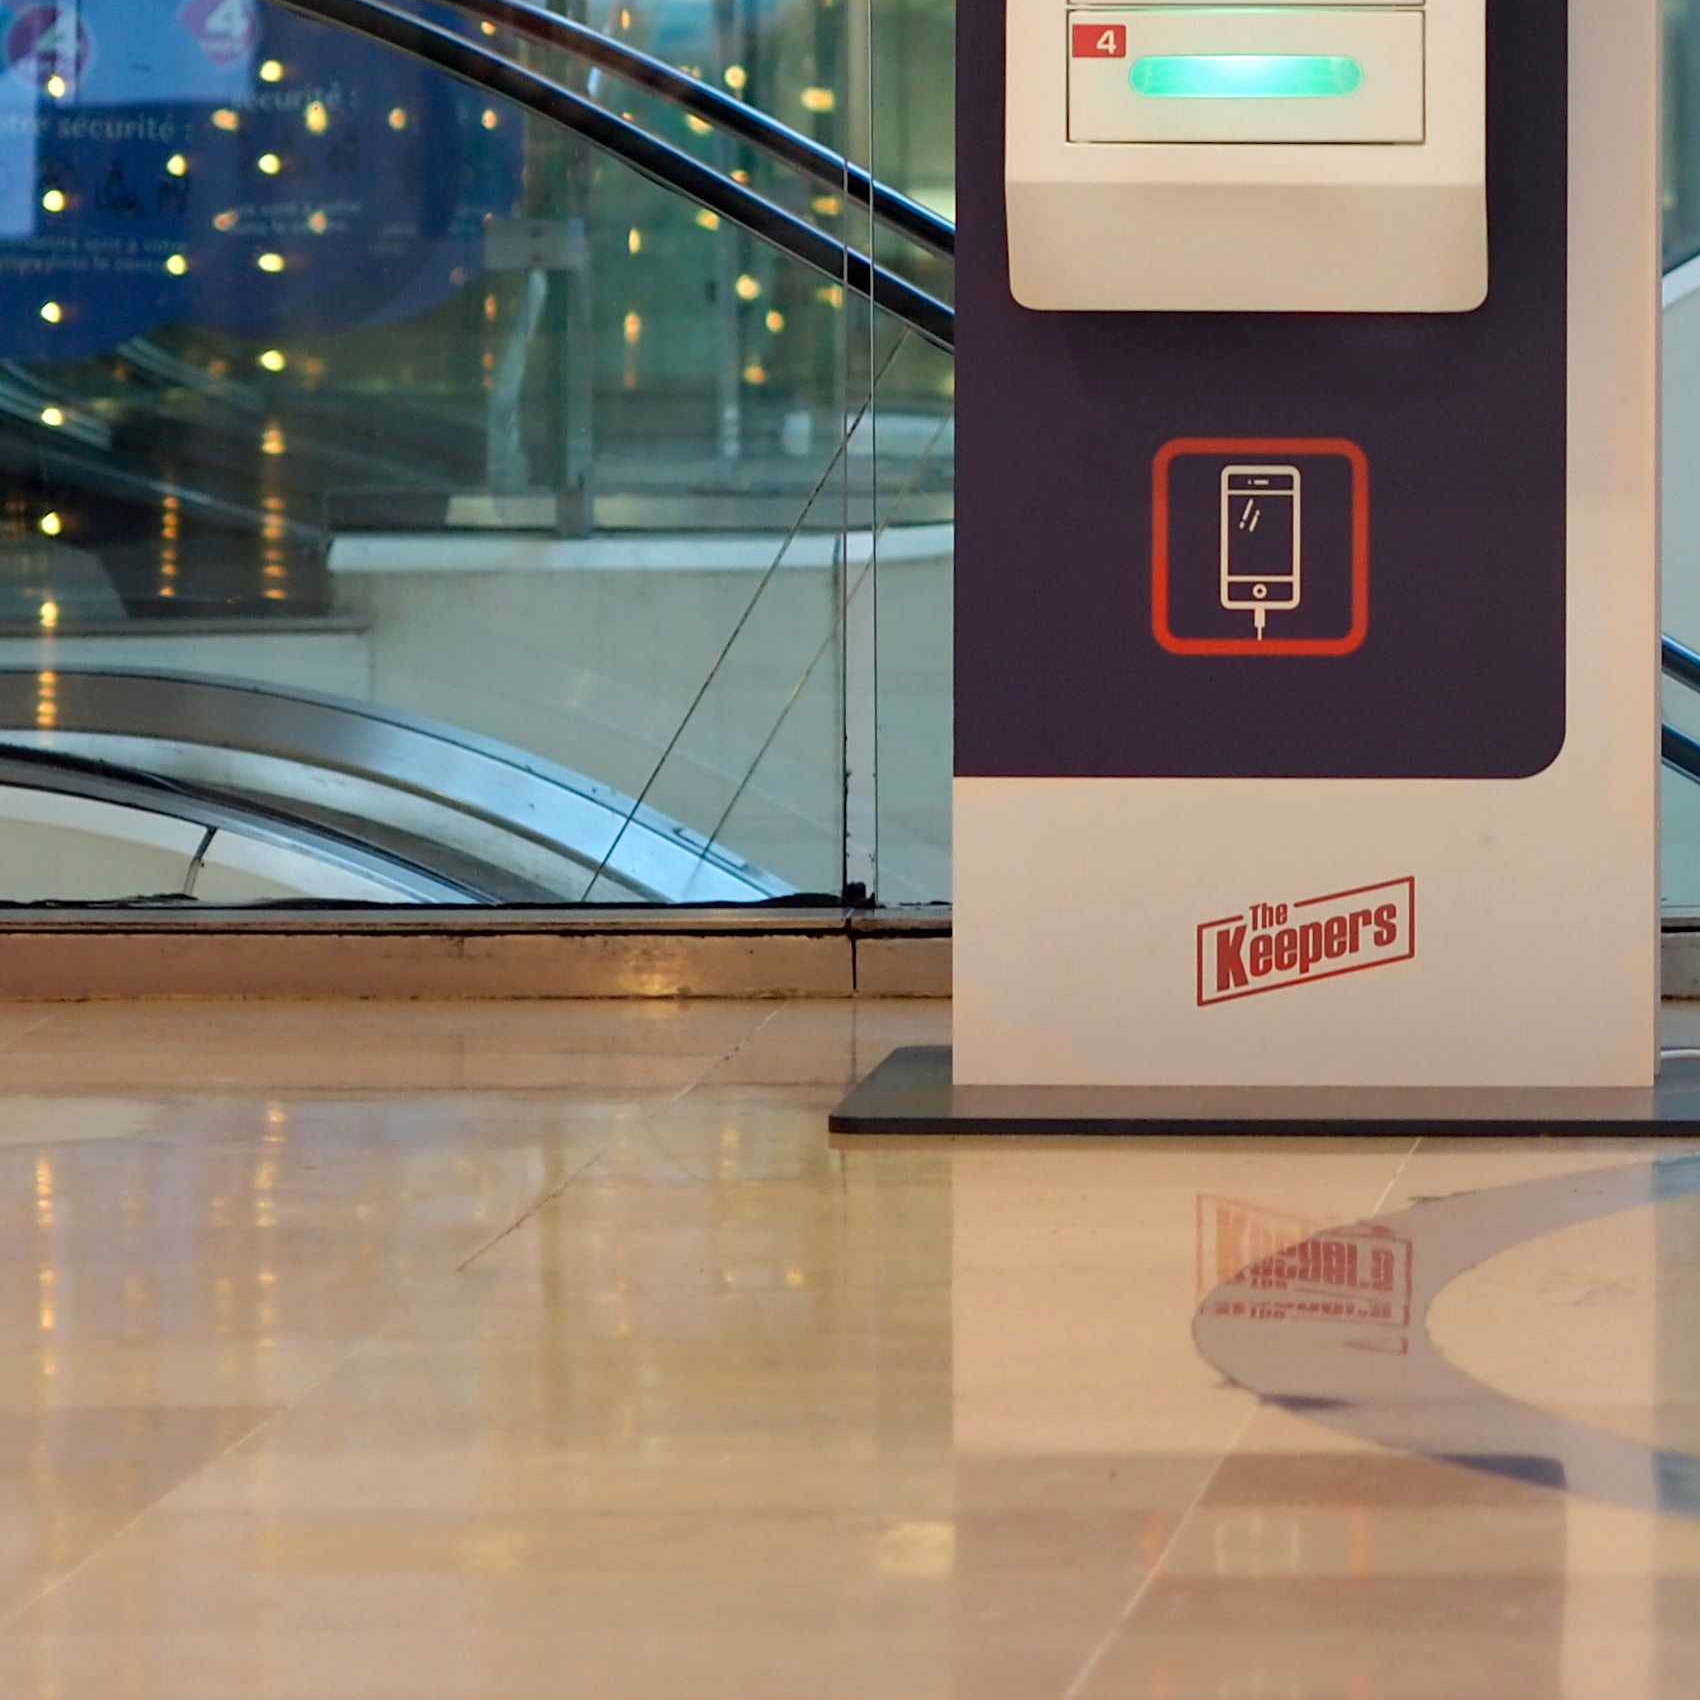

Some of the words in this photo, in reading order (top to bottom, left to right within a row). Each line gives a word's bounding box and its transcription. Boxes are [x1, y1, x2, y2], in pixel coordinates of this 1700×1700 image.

[1096, 29, 1117, 55] 4
[57, 112, 177, 144] sécurité
[1248, 902, 1288, 931] The
[1216, 903, 1397, 993] Keepers
